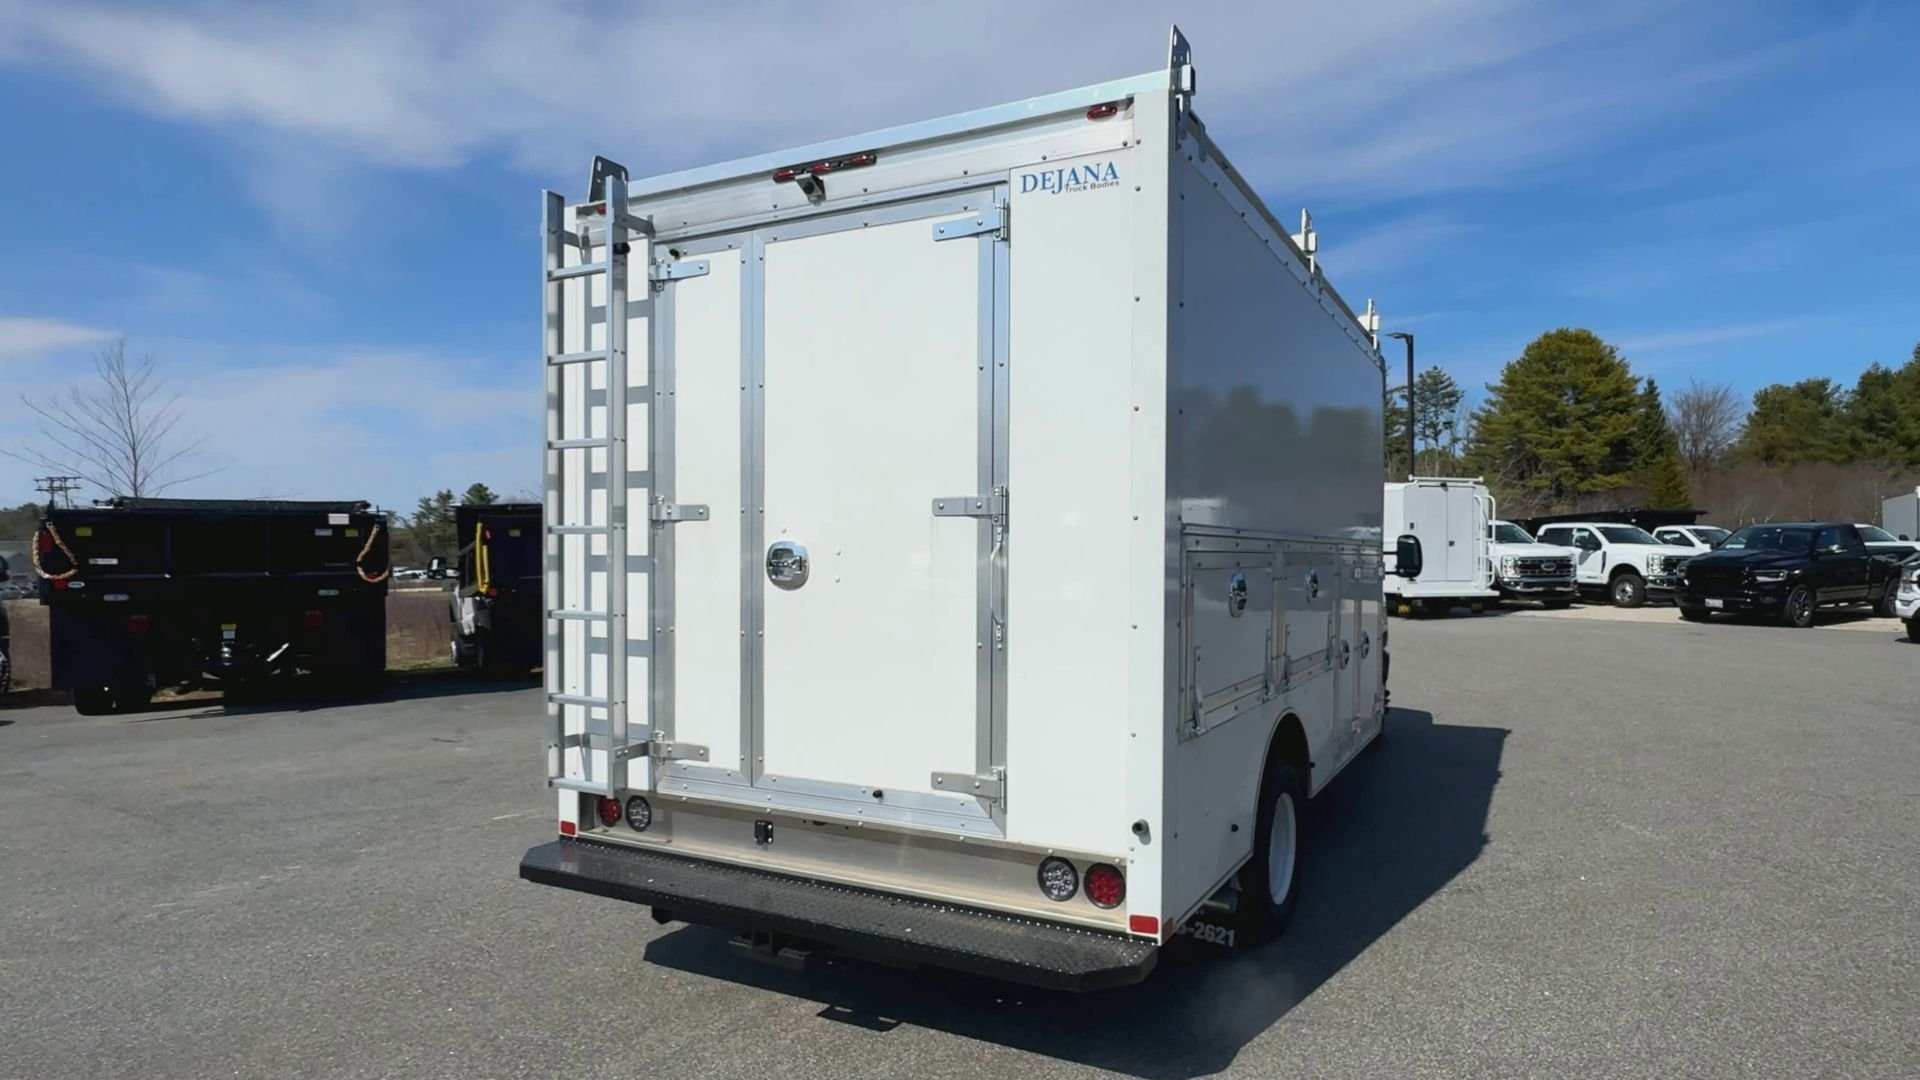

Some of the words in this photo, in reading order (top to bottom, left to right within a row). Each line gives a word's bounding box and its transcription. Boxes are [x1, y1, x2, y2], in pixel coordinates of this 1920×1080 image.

[1020, 161, 1120, 195] DEJANA
[1064, 184, 1088, 193] Truck
[1090, 180, 1120, 190] Bodies
